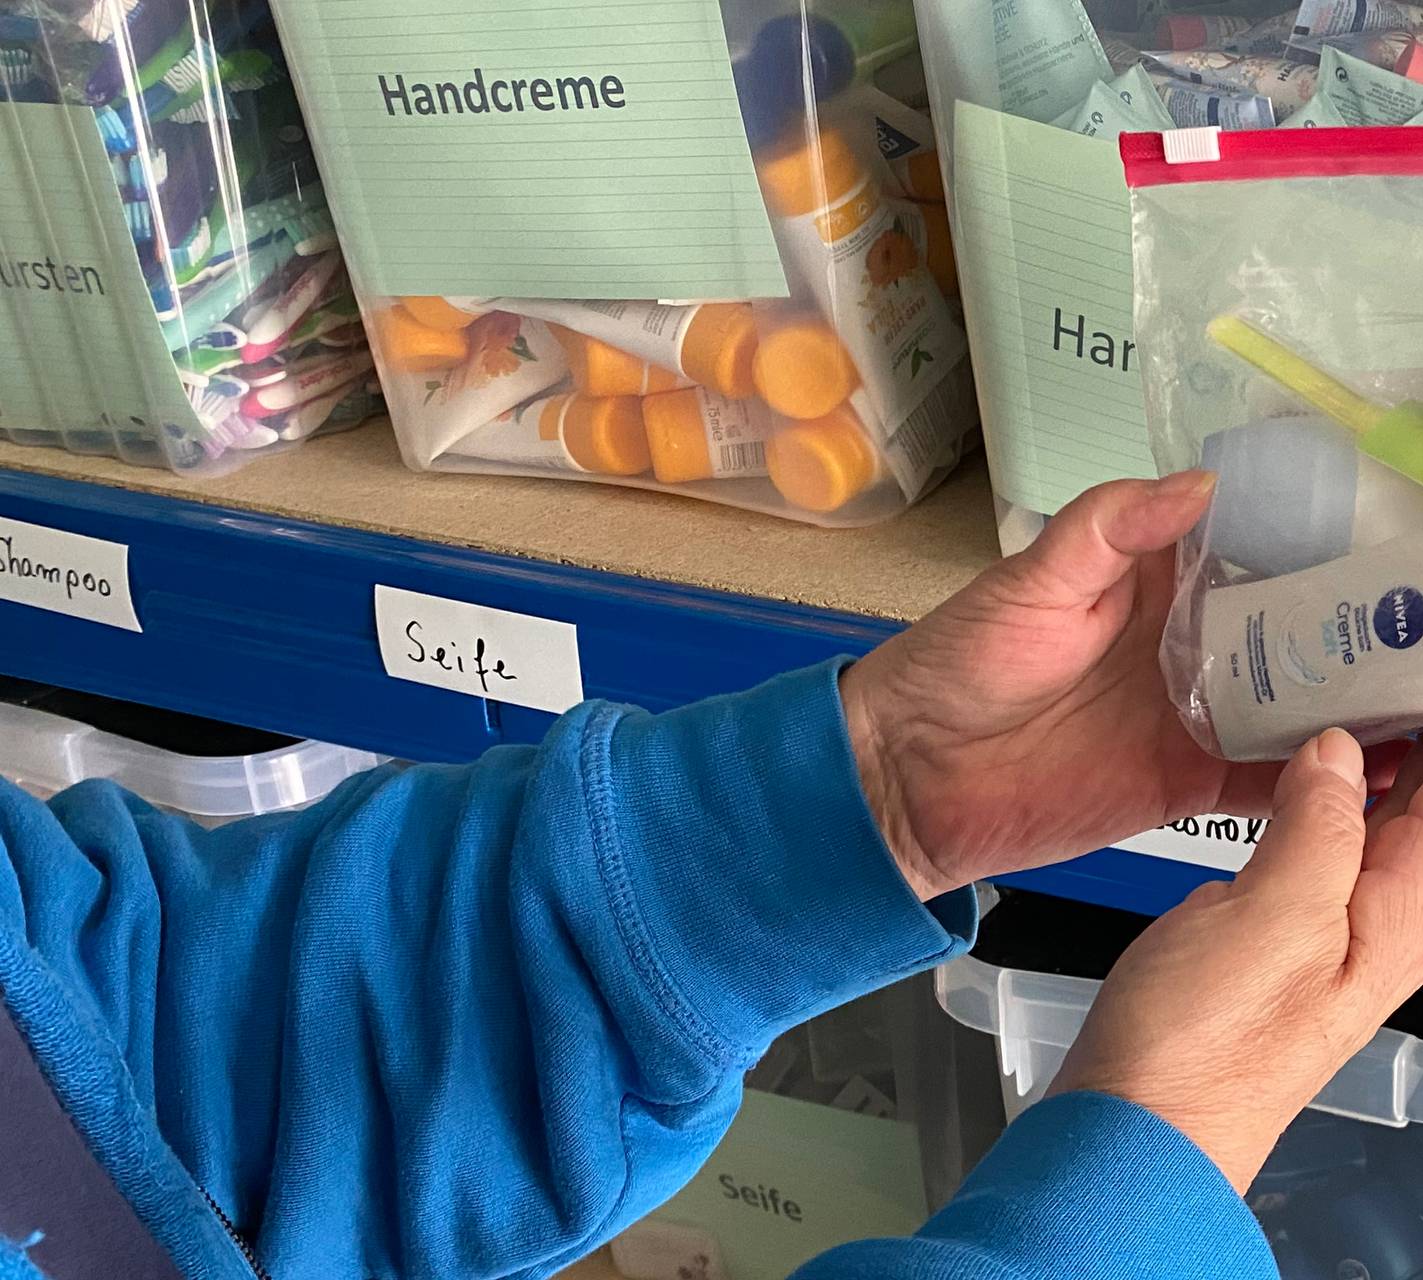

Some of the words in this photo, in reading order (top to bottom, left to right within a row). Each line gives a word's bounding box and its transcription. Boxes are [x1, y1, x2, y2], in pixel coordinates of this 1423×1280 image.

[377, 67, 626, 116] Handcreme
[1335, 601, 1356, 666] Creme
[1393, 594, 1410, 643] NIVEA
[405, 620, 518, 692] Seife
[719, 1173, 803, 1223] Seife
